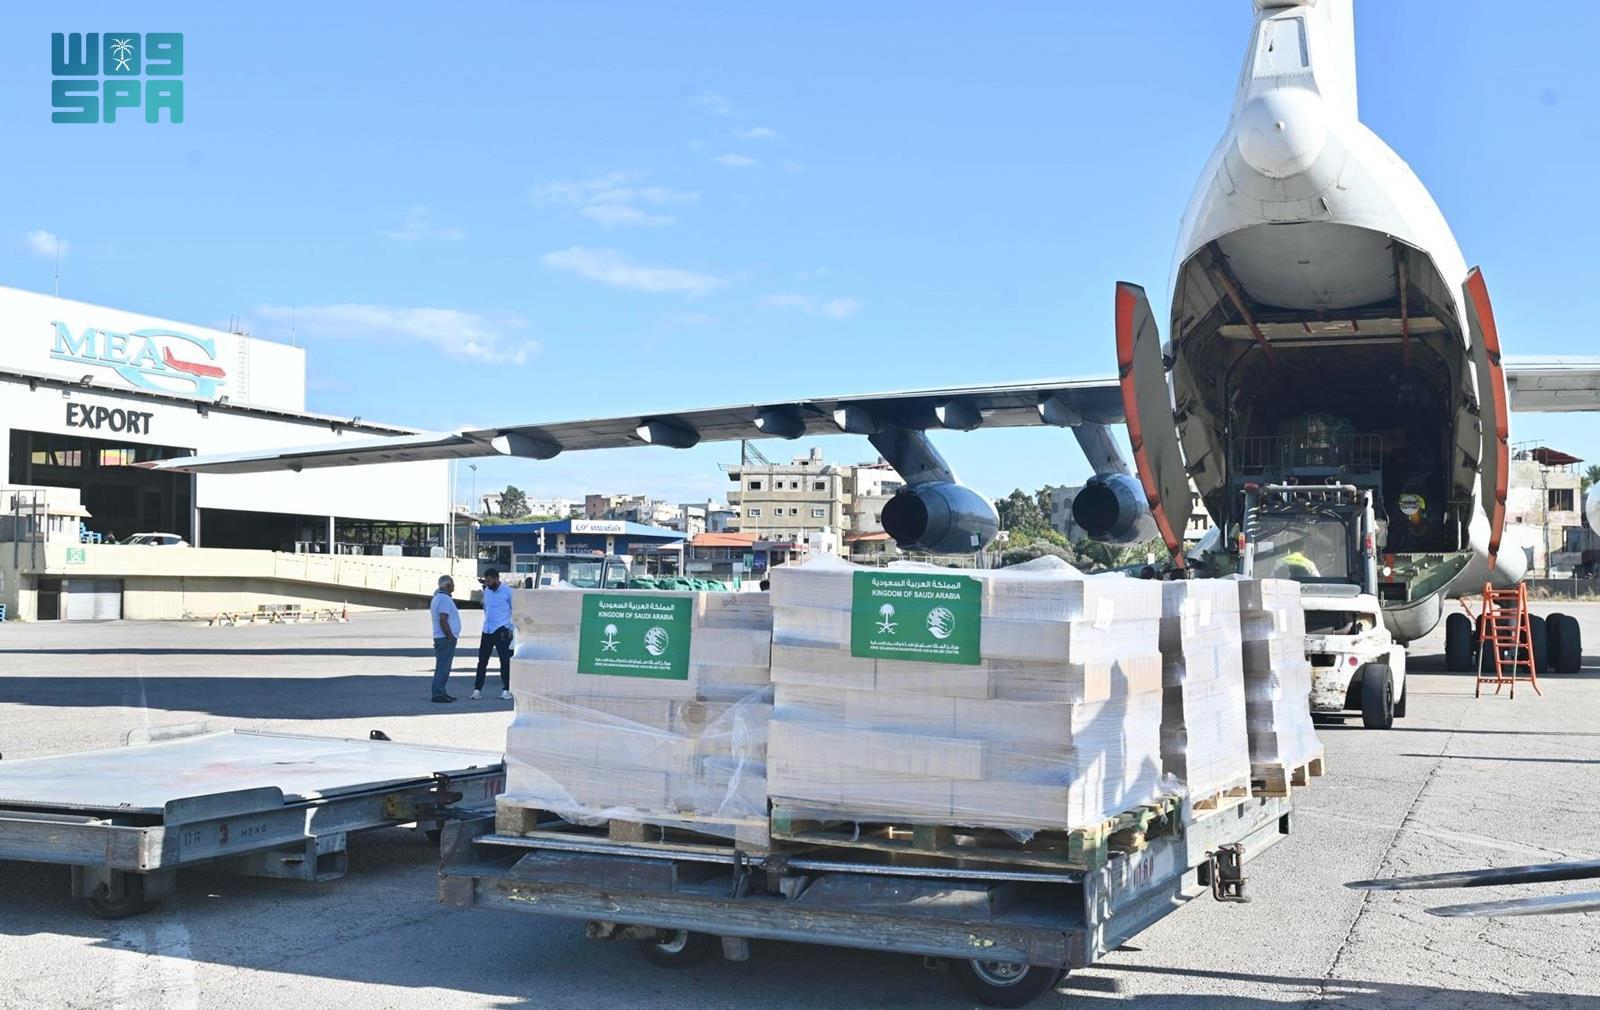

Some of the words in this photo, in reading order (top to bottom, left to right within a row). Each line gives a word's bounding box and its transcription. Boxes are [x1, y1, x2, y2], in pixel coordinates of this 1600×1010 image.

[66, 402, 153, 435] EXPORT
[872, 578, 905, 587] السعودية
[906, 579, 931, 588] العربية
[932, 581, 961, 589] المملكة
[871, 590, 903, 598] KINGDOM
[904, 590, 913, 598] OF
[914, 591, 935, 599] SAUDI
[935, 591, 961, 600] ARABIA
[599, 601, 628, 609] السعودية
[628, 602, 649, 610] العربية
[650, 603, 674, 611] المملكة
